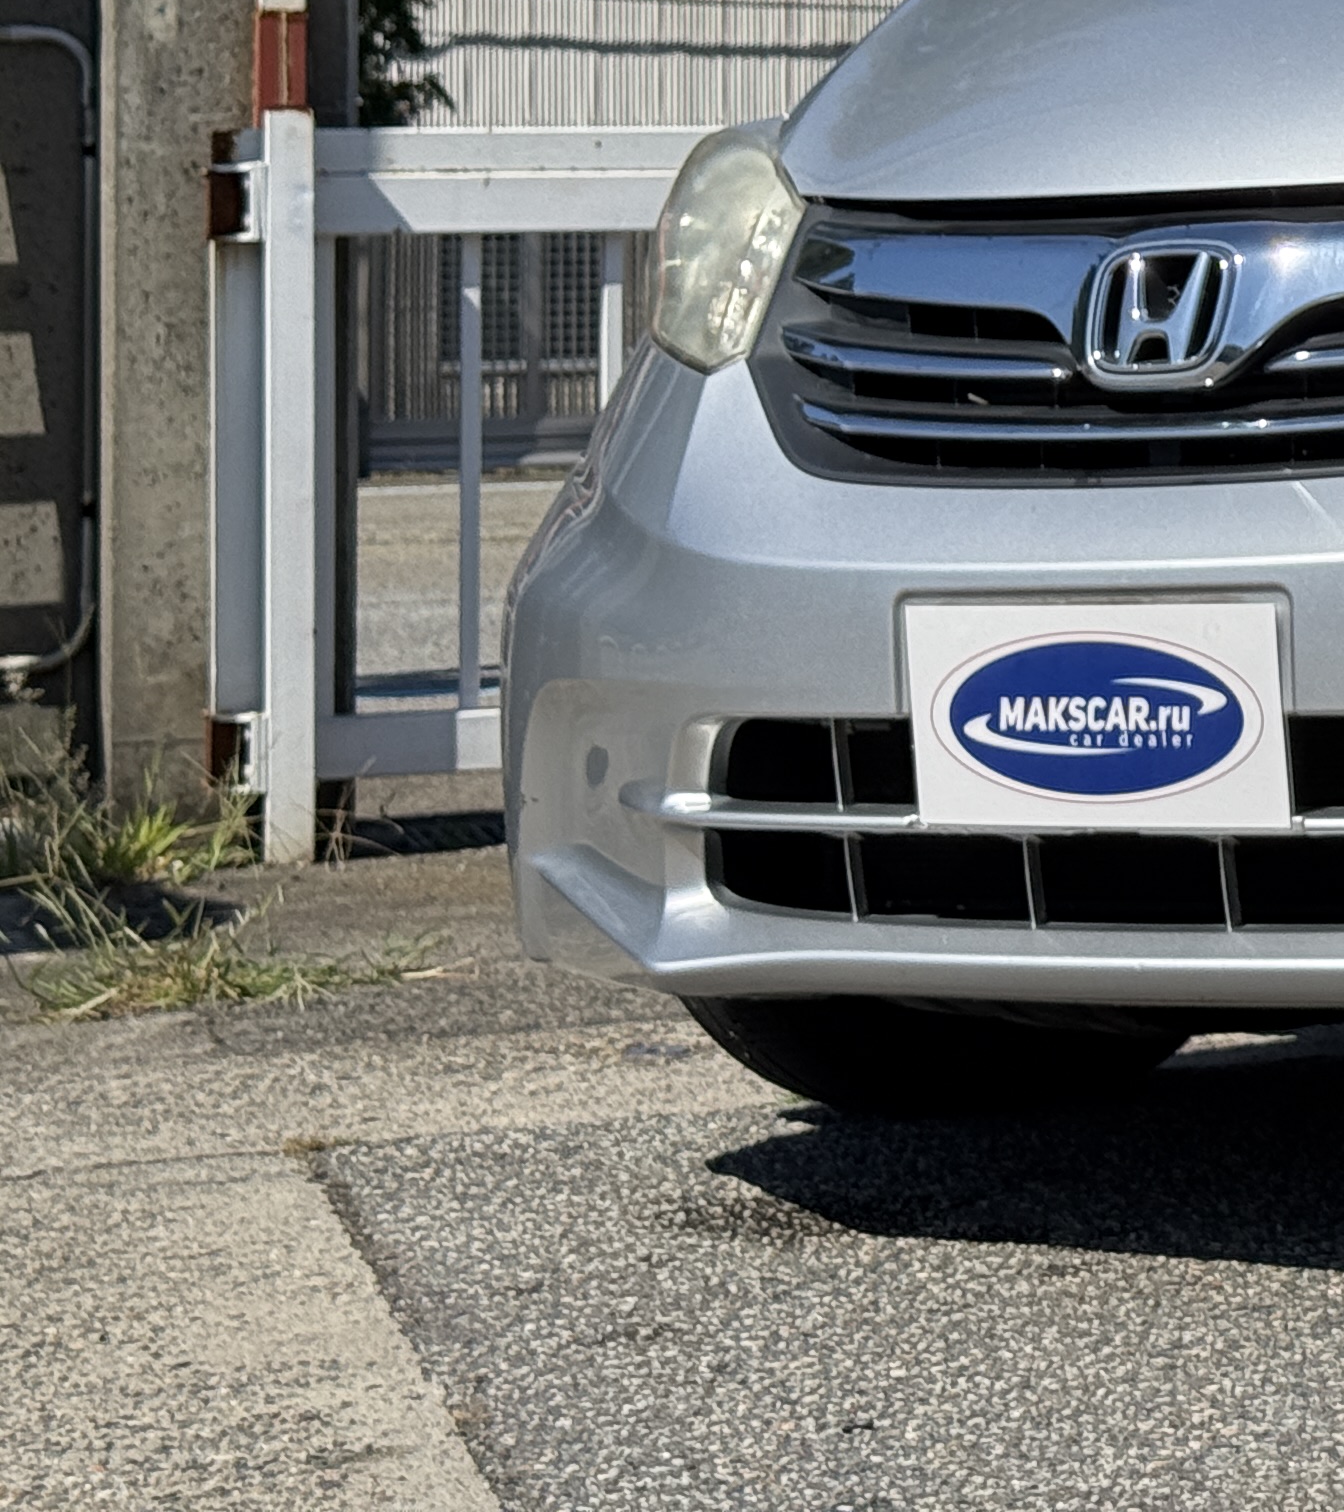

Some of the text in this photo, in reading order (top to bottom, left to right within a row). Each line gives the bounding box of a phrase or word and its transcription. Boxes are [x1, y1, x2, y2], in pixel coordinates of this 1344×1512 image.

[999, 695, 1191, 732] MAKSCAR.ru
[1069, 731, 1194, 748] car dealer
